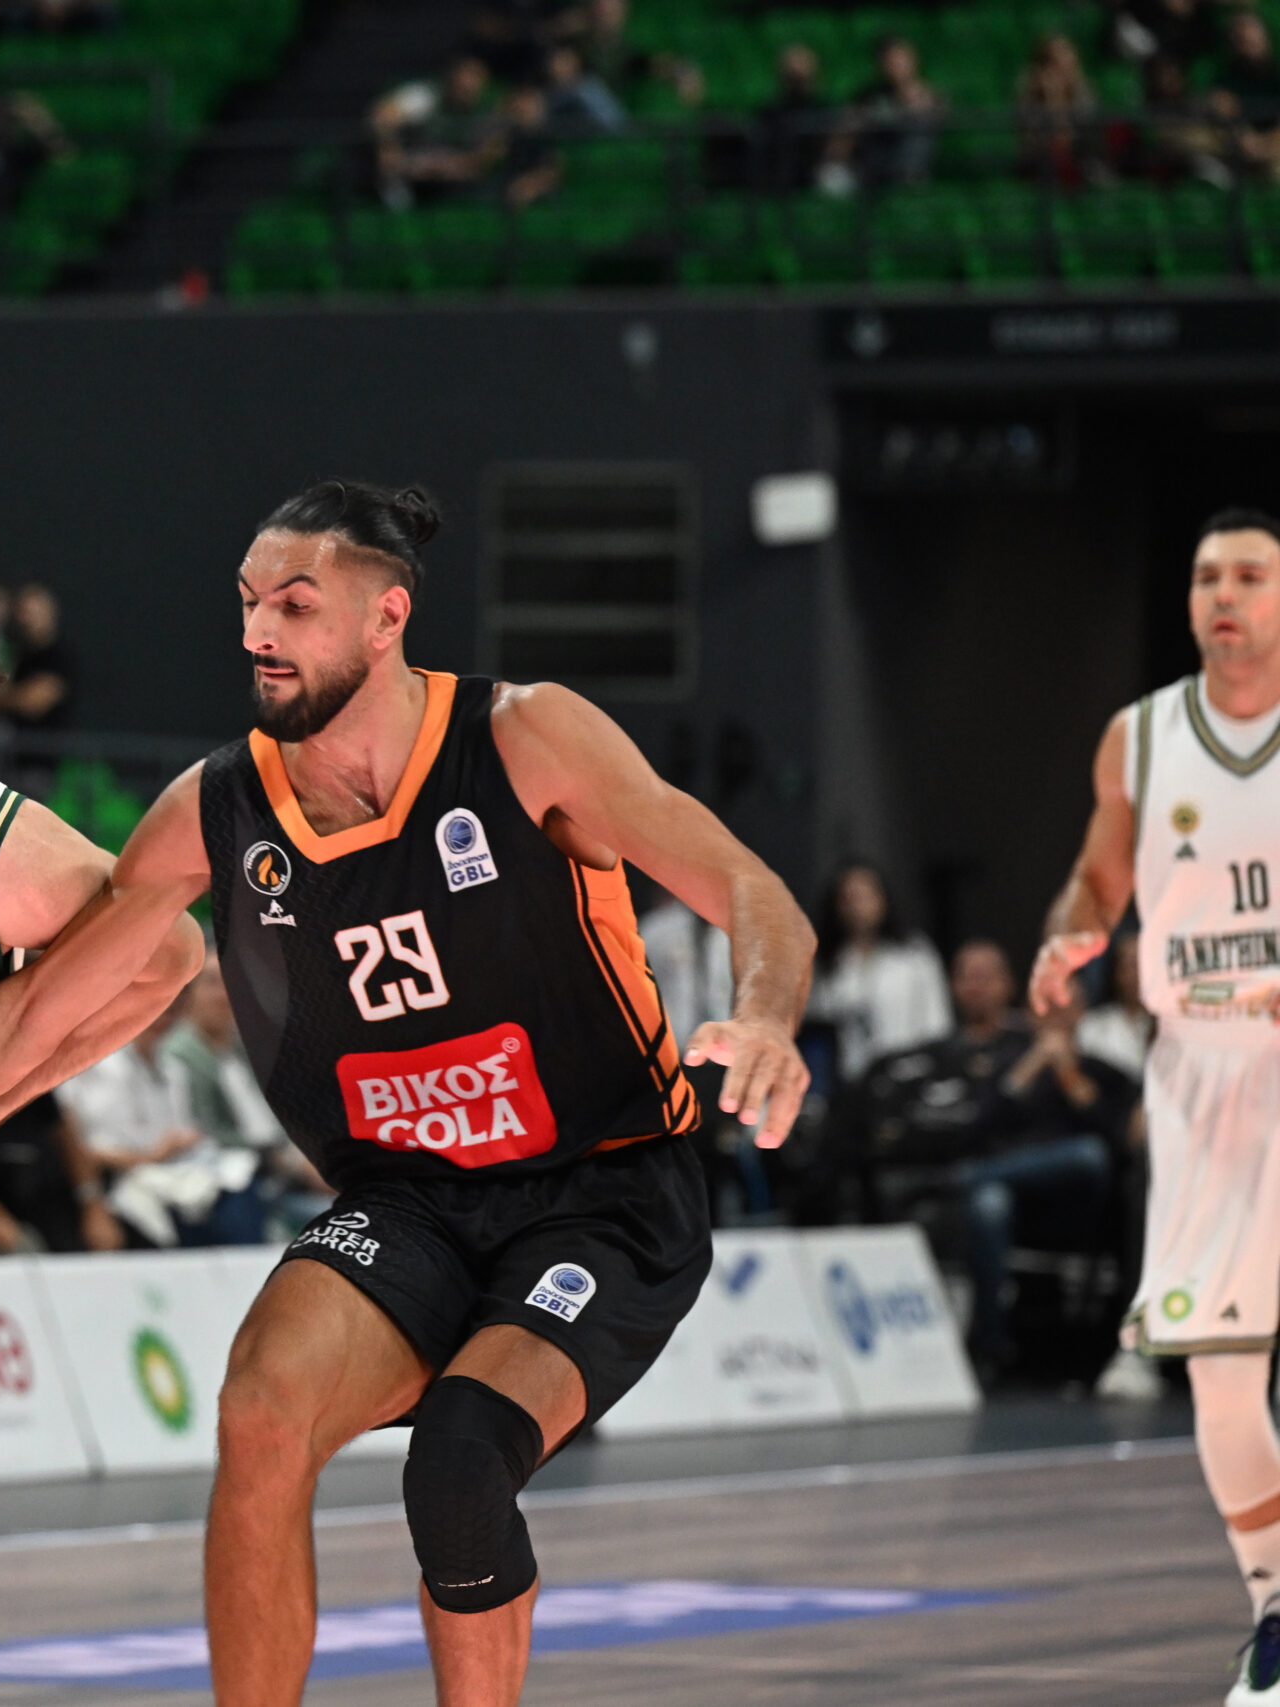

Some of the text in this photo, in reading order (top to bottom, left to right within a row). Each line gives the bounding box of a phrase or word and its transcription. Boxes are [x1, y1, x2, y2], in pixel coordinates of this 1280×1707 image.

[450, 863, 493, 887] GBL
[1228, 860, 1269, 915] 10
[333, 908, 451, 1022] 29
[376, 1096, 528, 1150] COLA
[532, 1293, 571, 1319] GBL
